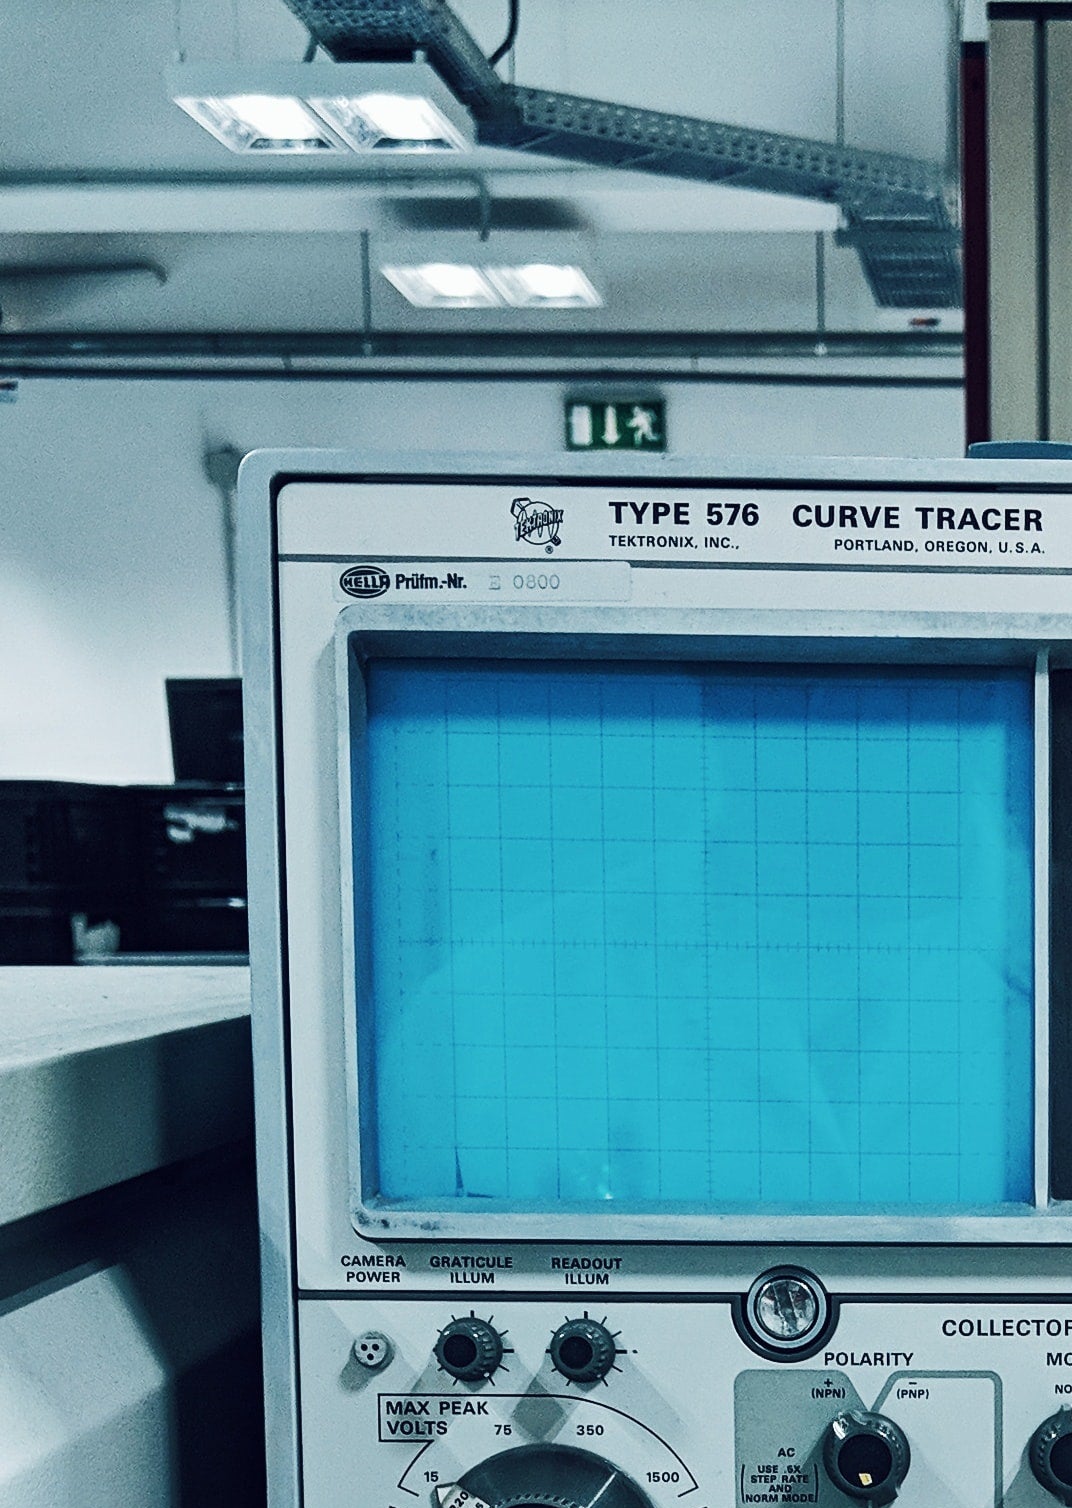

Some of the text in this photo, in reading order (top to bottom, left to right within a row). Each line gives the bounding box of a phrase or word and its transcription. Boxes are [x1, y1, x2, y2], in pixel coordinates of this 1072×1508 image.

[609, 501, 1043, 531] TYPE 576 CURVE TRACER
[609, 535, 698, 549] TEKTRONIX,
[834, 538, 919, 554] PORTLAND,
[925, 541, 993, 554] OREGON,
[344, 576, 389, 589] HELLA
[396, 574, 467, 589] Prüfm.-Nr.
[513, 574, 560, 589] 0800
[341, 1256, 406, 1267] CAMERA
[430, 1256, 513, 1268] GRATICULE
[551, 1257, 622, 1269] READOUT
[346, 1271, 401, 1283] POWER
[450, 1272, 495, 1284] ILLUM
[565, 1273, 609, 1285] ILLUM
[824, 1352, 914, 1366] POLARITY
[811, 1388, 846, 1399] (NPN)
[897, 1388, 929, 1399] (PNP)
[386, 1402, 489, 1415] MAX PEAK
[387, 1421, 448, 1435] VOLTS
[494, 1425, 512, 1436] 75
[576, 1425, 604, 1436] 350
[778, 1448, 796, 1457] AC
[424, 1471, 438, 1483] 15
[646, 1471, 680, 1483] 1500
